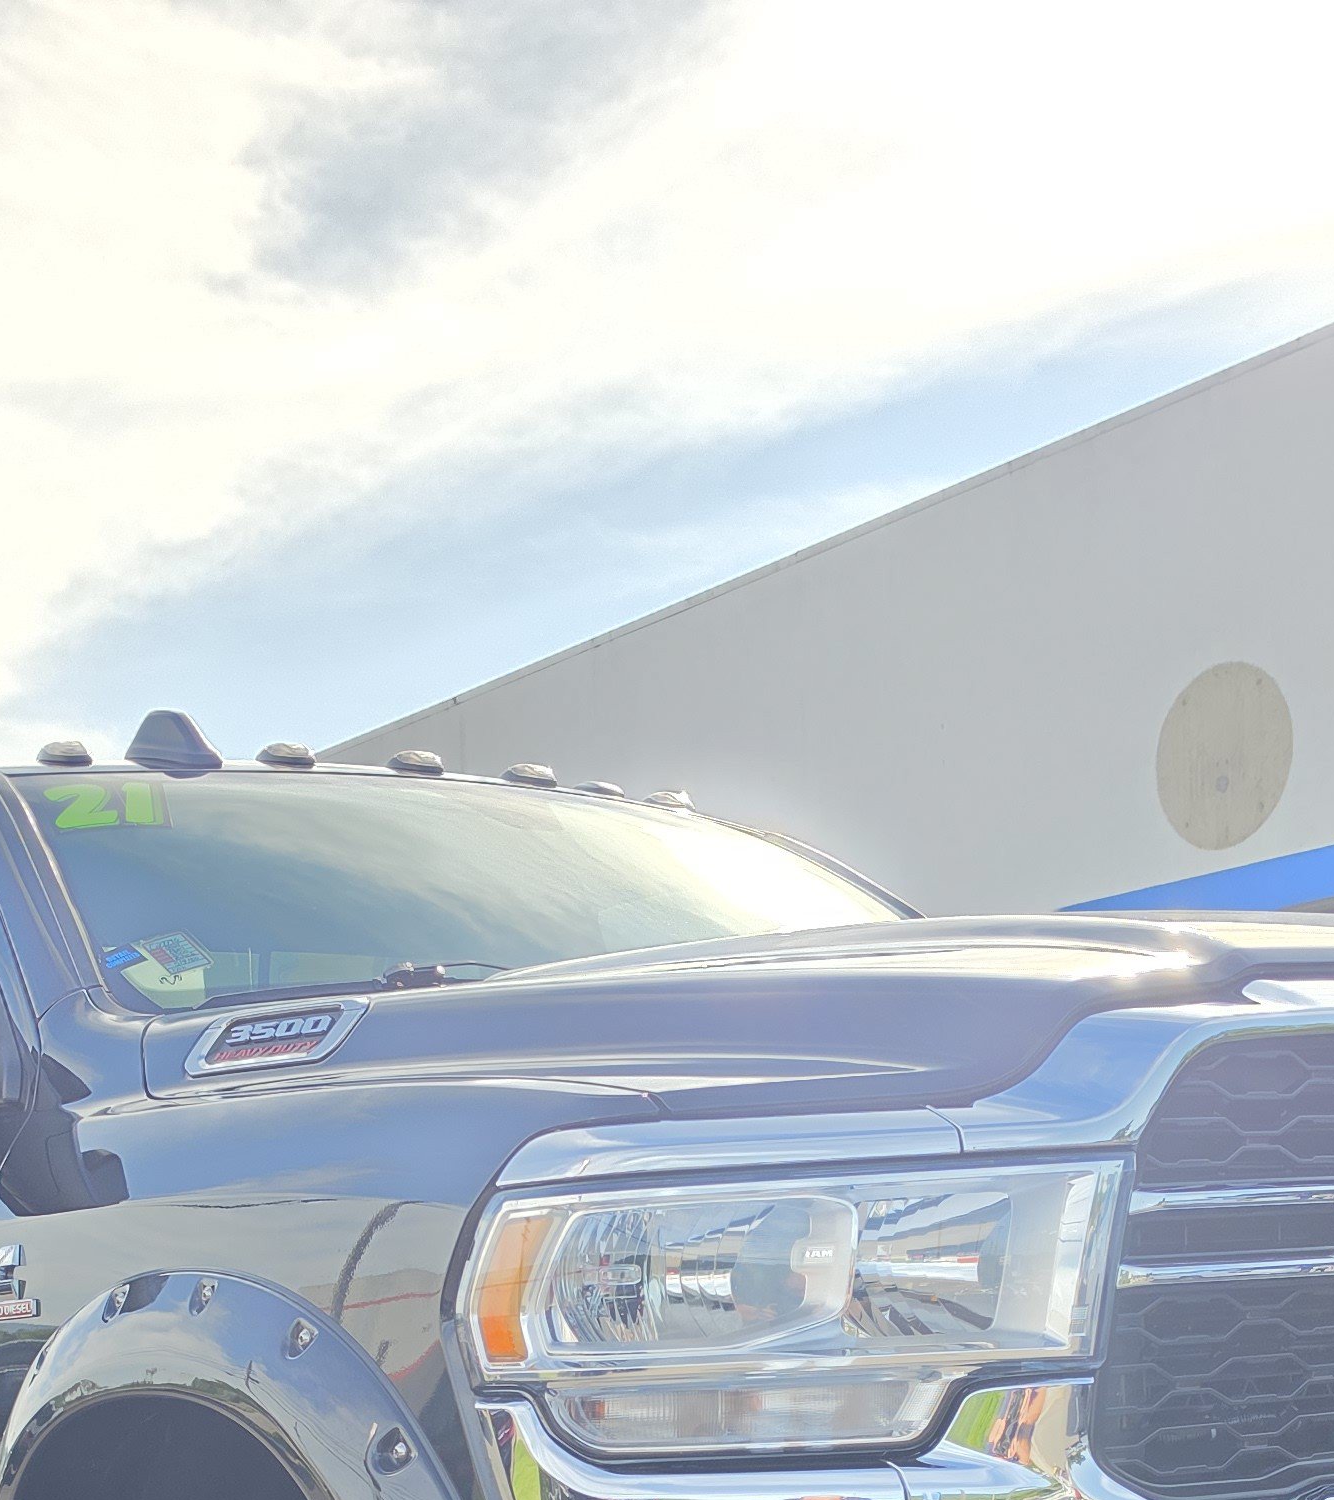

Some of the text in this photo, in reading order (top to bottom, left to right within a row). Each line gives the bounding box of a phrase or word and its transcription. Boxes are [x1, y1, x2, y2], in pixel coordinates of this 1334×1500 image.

[43, 782, 165, 829] 21
[225, 1015, 333, 1044] 3500
[213, 1040, 318, 1061] HEAVY DUTY
[4, 1302, 32, 1316] DIESEL
